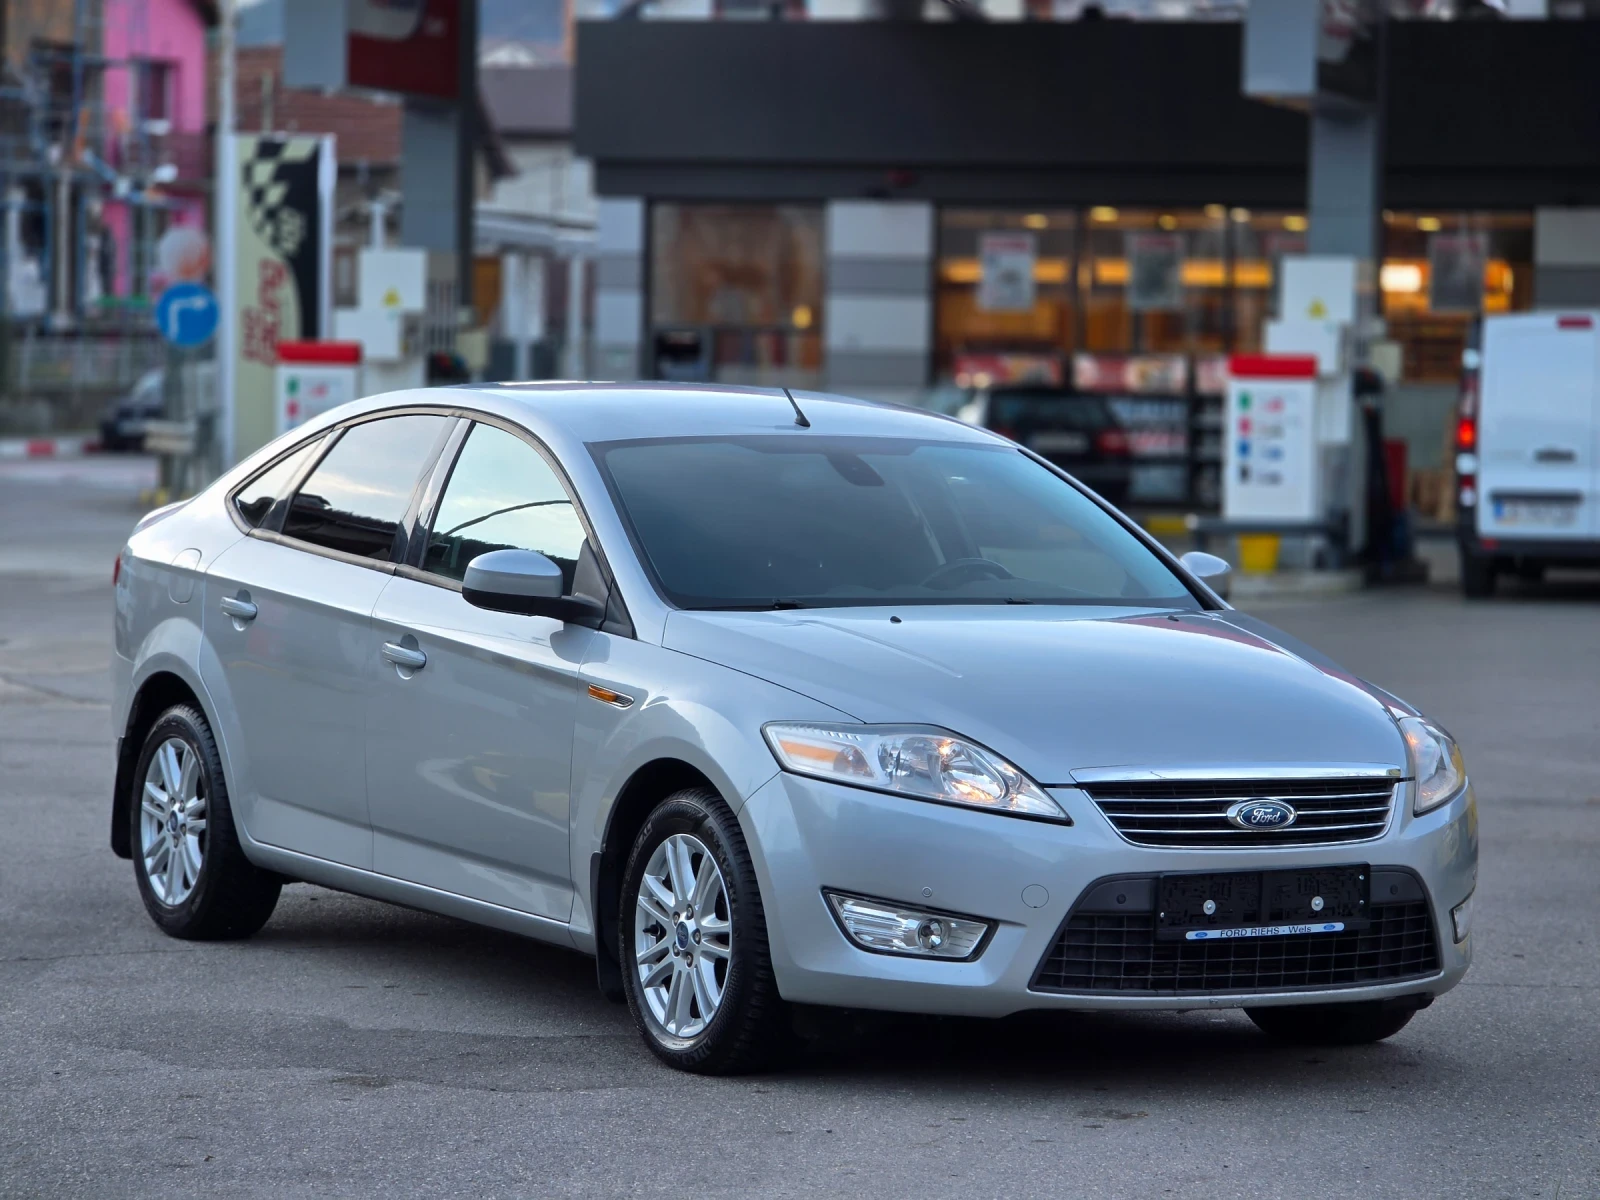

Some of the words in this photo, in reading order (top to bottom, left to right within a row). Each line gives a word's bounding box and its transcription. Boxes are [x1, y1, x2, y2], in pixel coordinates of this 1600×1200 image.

[1251, 808, 1281, 823] Ford
[1220, 928, 1248, 938] FORD
[1250, 927, 1280, 936] RIEHS
[1288, 925, 1312, 934] Wels
